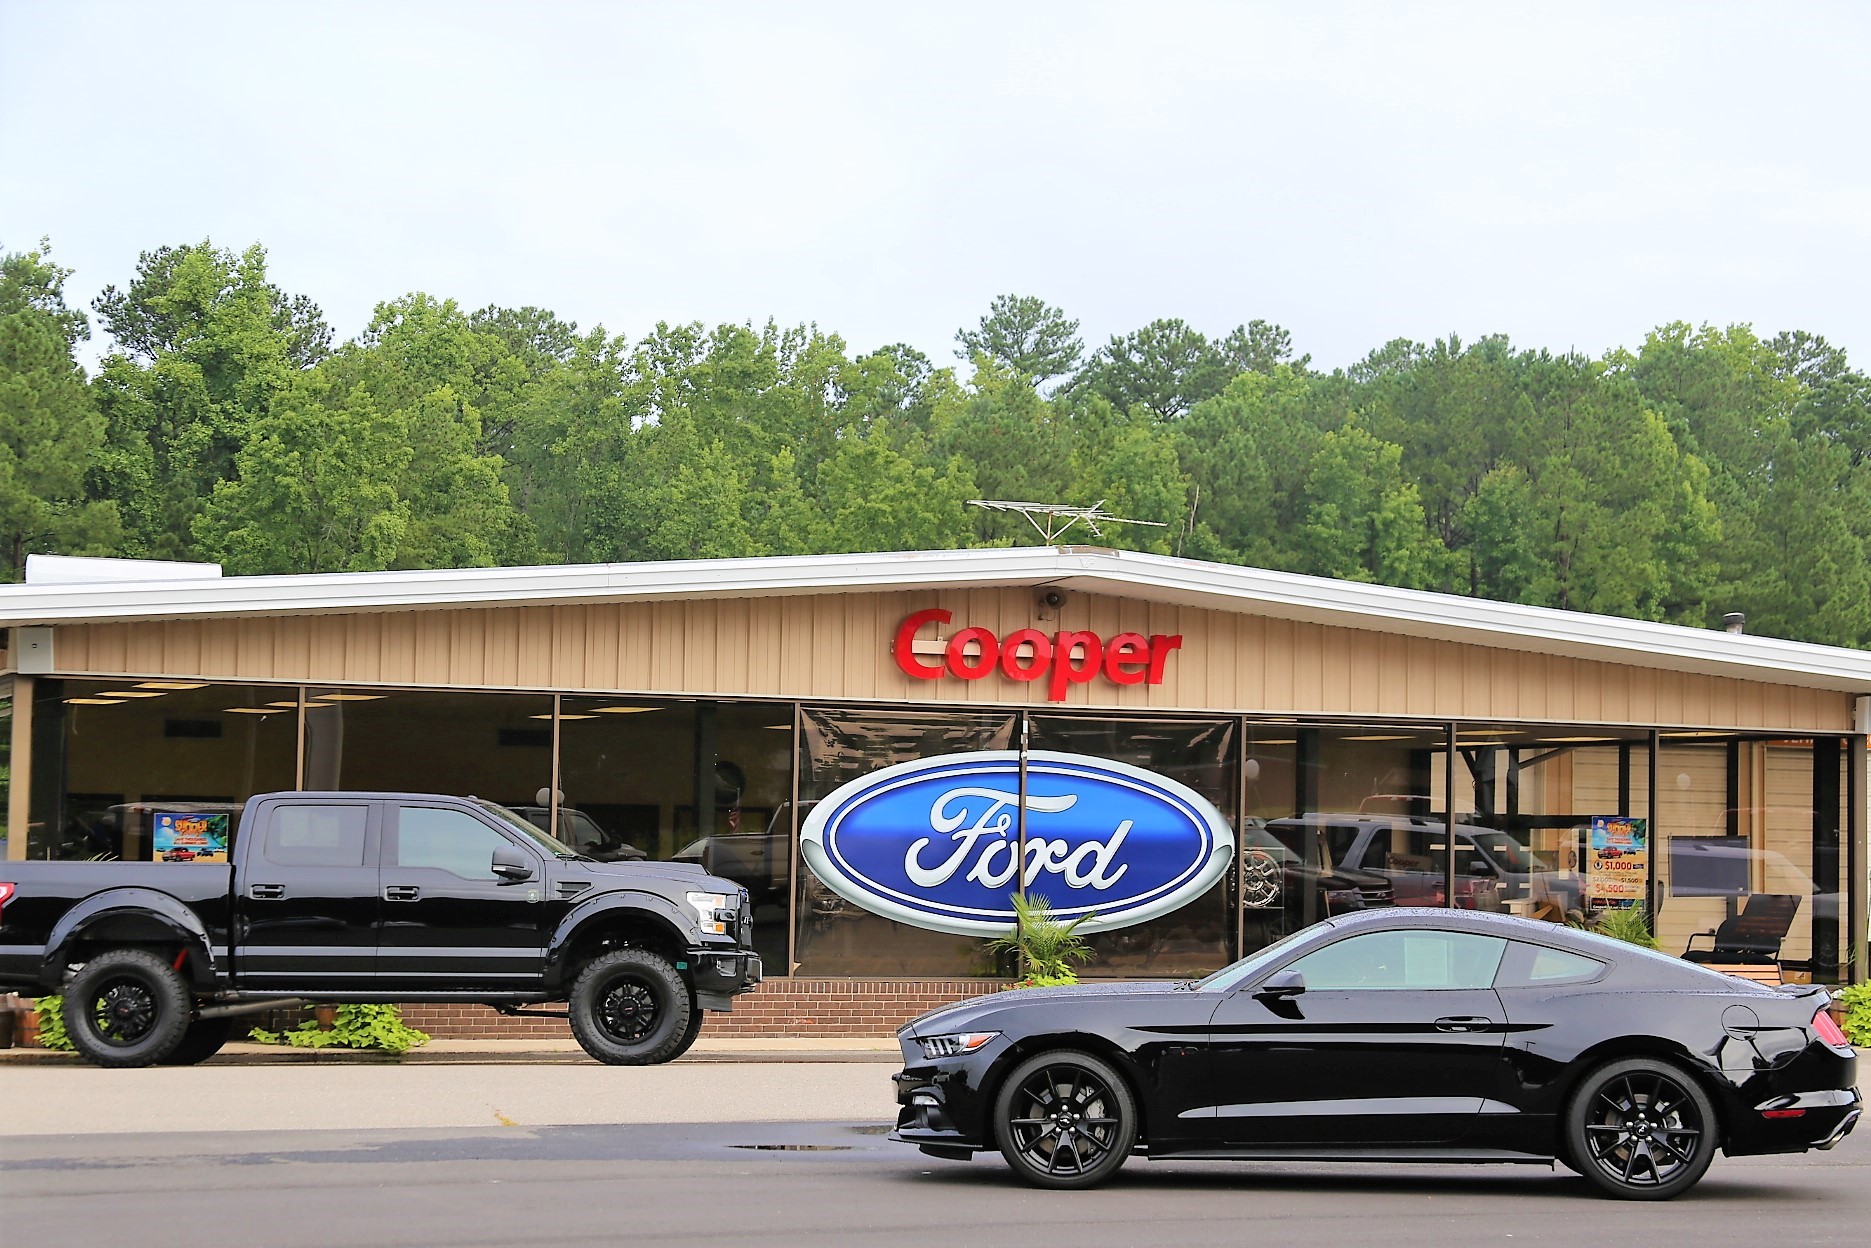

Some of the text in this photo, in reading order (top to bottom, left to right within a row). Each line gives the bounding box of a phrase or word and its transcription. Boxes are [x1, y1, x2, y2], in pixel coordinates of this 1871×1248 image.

[894, 608, 1183, 702] Cooper
[904, 786, 1134, 890] Ford
[1605, 861, 1632, 870] $1,000
